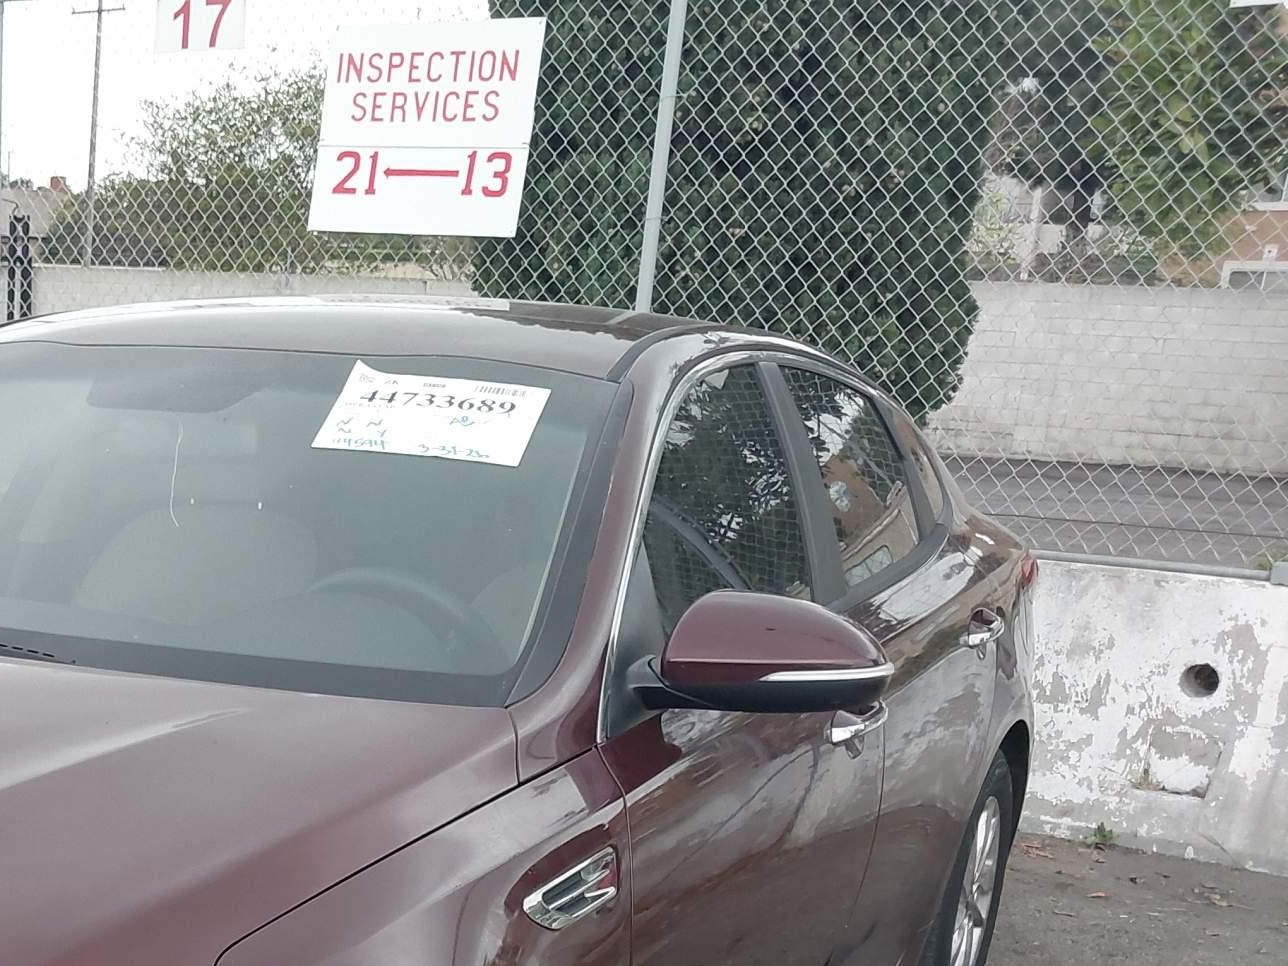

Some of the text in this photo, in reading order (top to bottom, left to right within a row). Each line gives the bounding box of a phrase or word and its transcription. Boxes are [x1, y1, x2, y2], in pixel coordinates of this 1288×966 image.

[173, 0, 231, 49] 17
[337, 50, 520, 83] INSPECTION
[351, 90, 500, 122] SERVICES
[332, 151, 513, 198] 21 13
[360, 390, 516, 415] 44733689
